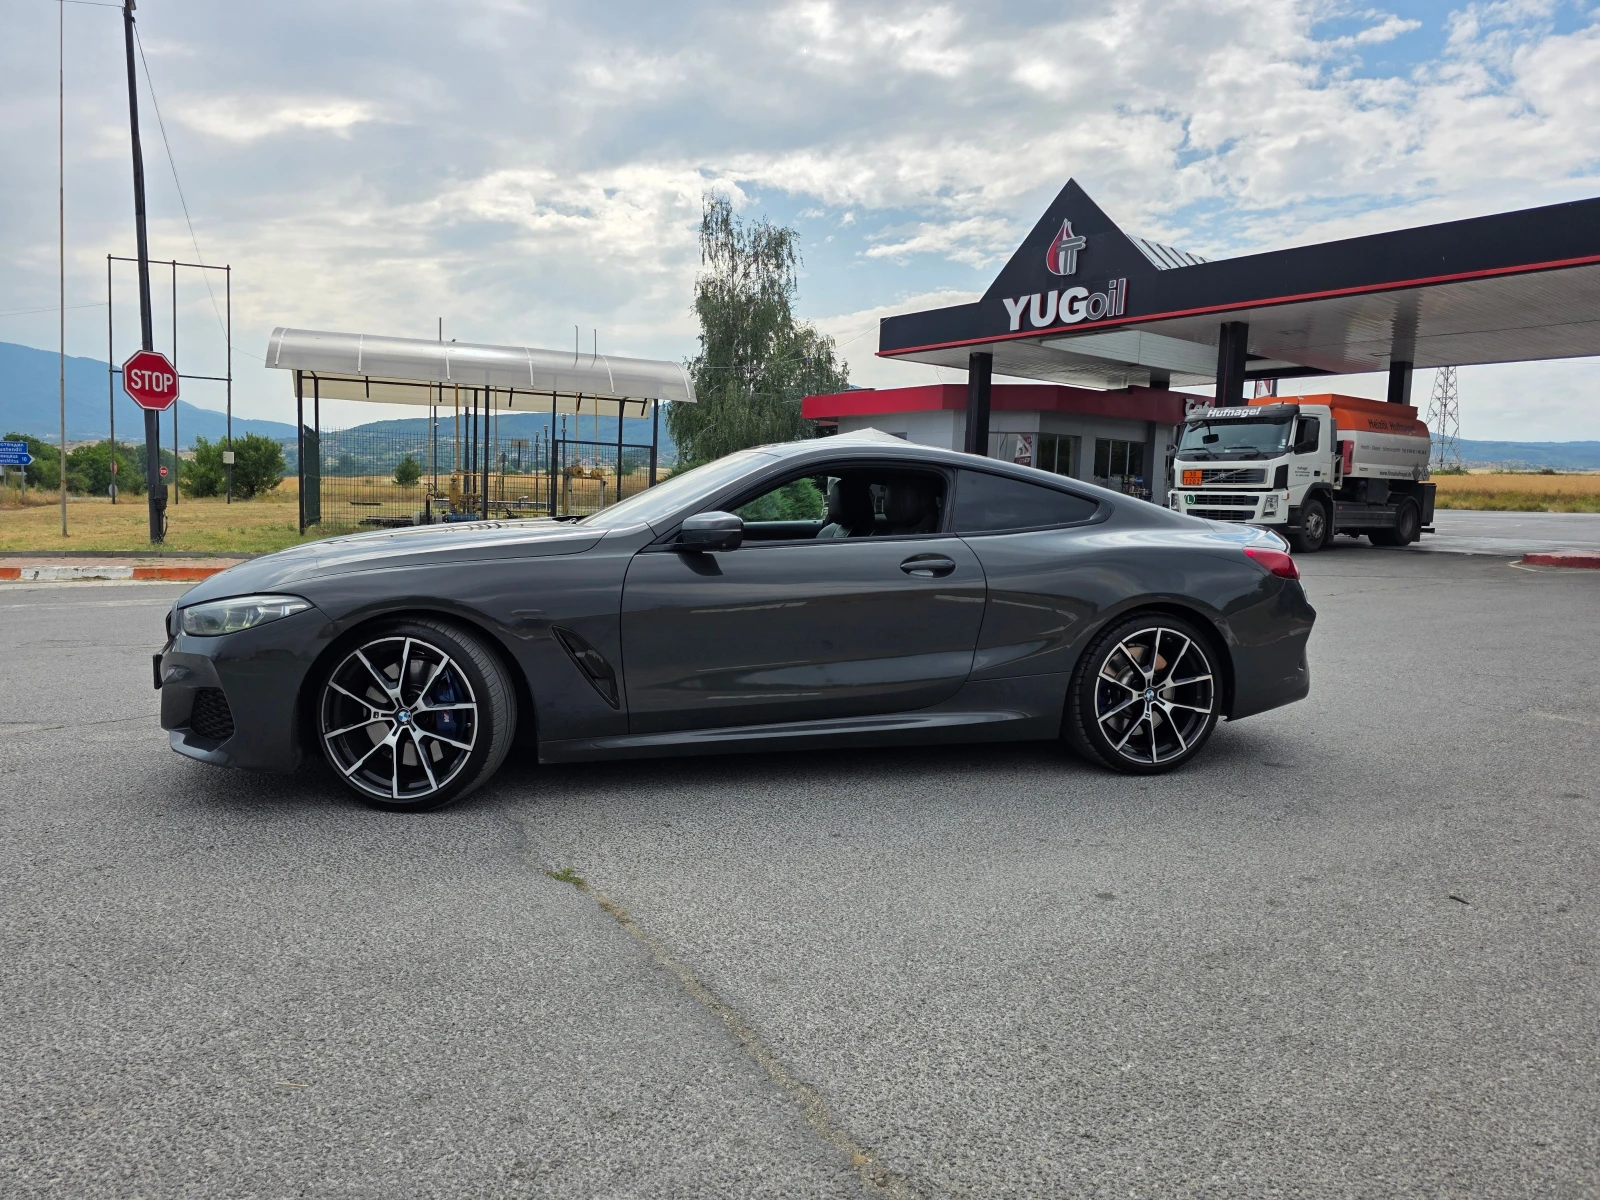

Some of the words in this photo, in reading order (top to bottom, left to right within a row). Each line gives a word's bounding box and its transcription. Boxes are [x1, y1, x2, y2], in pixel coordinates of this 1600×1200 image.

[1002, 278, 1127, 331] YUGoil
[131, 369, 174, 393] STOP
[1206, 407, 1262, 418] Hufnagel
